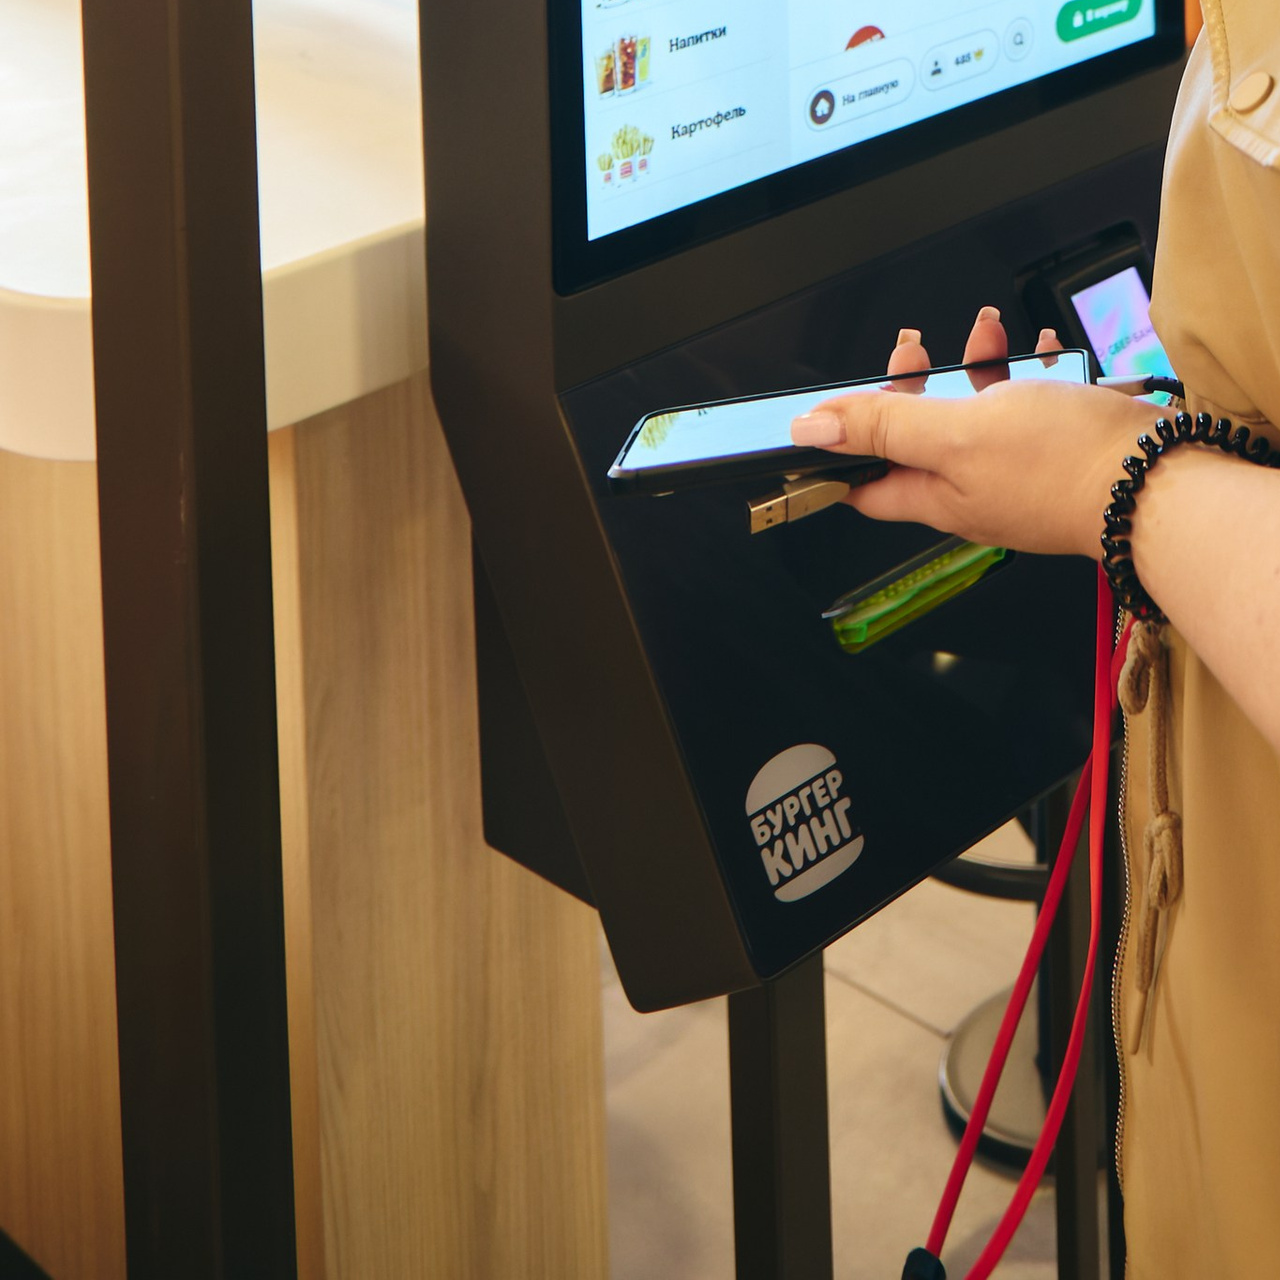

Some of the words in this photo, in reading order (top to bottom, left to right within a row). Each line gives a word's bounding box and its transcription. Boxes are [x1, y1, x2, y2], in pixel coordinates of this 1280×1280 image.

[669, 26, 727, 53] Напитки
[842, 93, 856, 106] На
[857, 78, 899, 102] главную
[671, 105, 747, 140] Картофель
[750, 769, 843, 846] БУРГЕР
[760, 796, 852, 886] КИНГ
